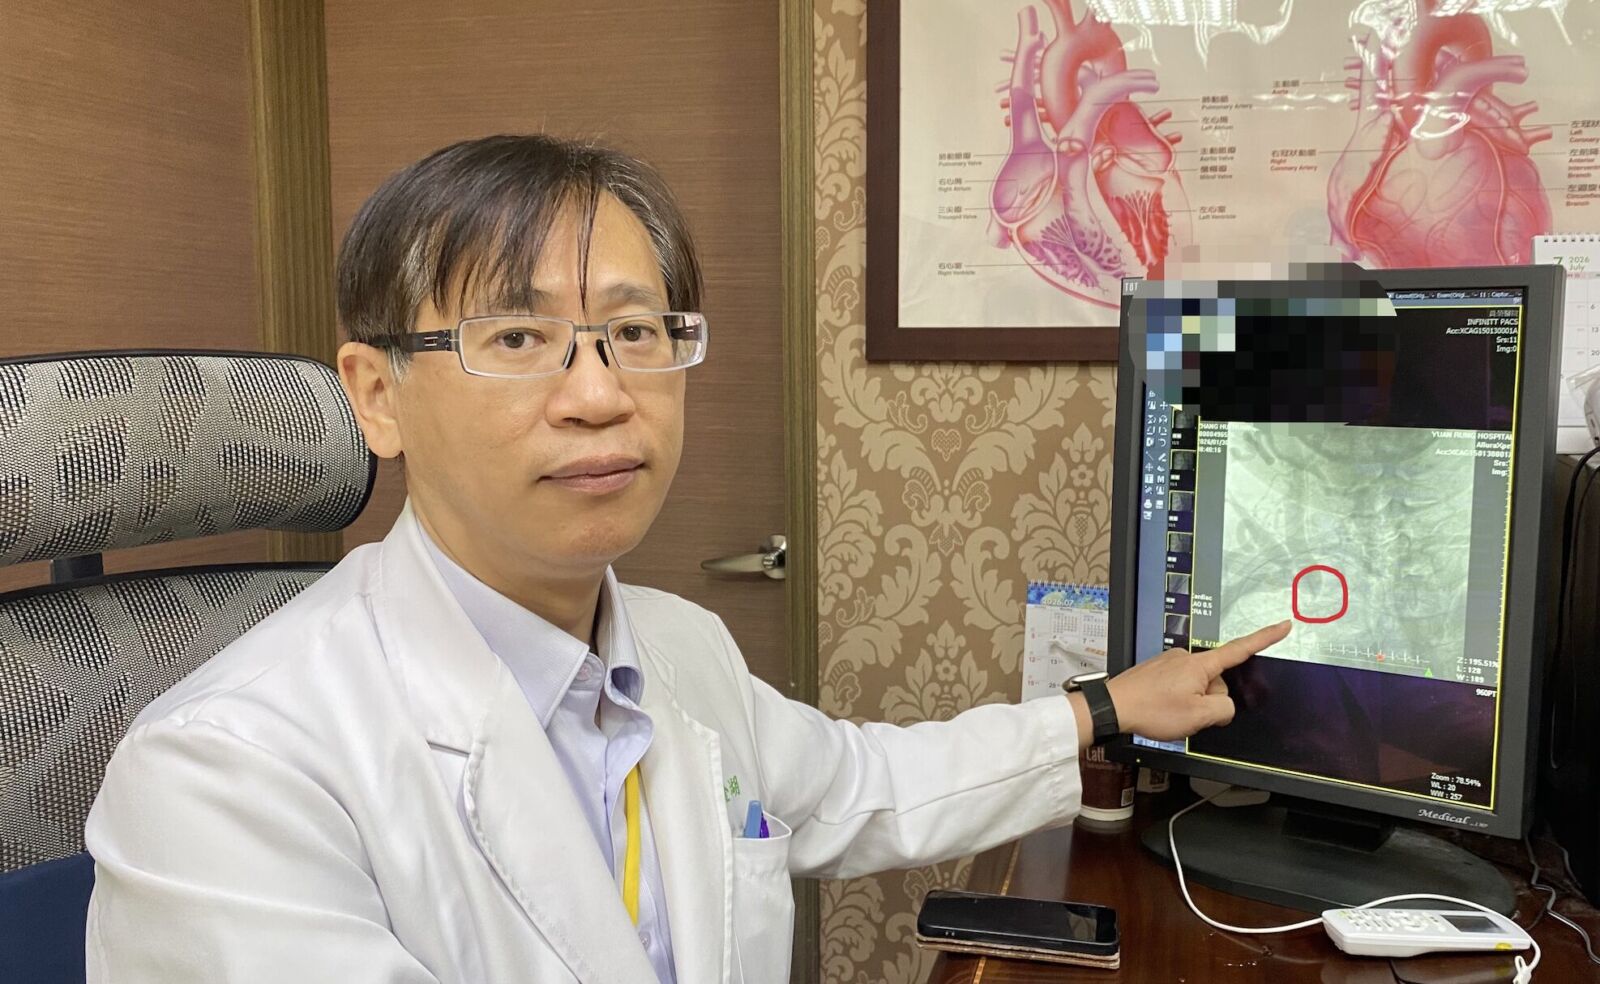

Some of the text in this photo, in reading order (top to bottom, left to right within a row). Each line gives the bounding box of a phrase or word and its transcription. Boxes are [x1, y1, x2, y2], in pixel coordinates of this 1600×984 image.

[1569, 256, 1590, 264] 2026
[1569, 263, 1585, 272] July
[1467, 318, 1499, 326] INFINITT
[1431, 431, 1453, 439] YUAN
[1493, 459, 1510, 467] Srs:
[1491, 468, 1510, 477] Img:
[1431, 772, 1450, 782] Zoom
[1455, 776, 1482, 788] 78.54%
[1430, 780, 1442, 790] WL
[1447, 783, 1457, 792] 20
[1449, 793, 1463, 801] 257
[1418, 808, 1471, 825] Medical
